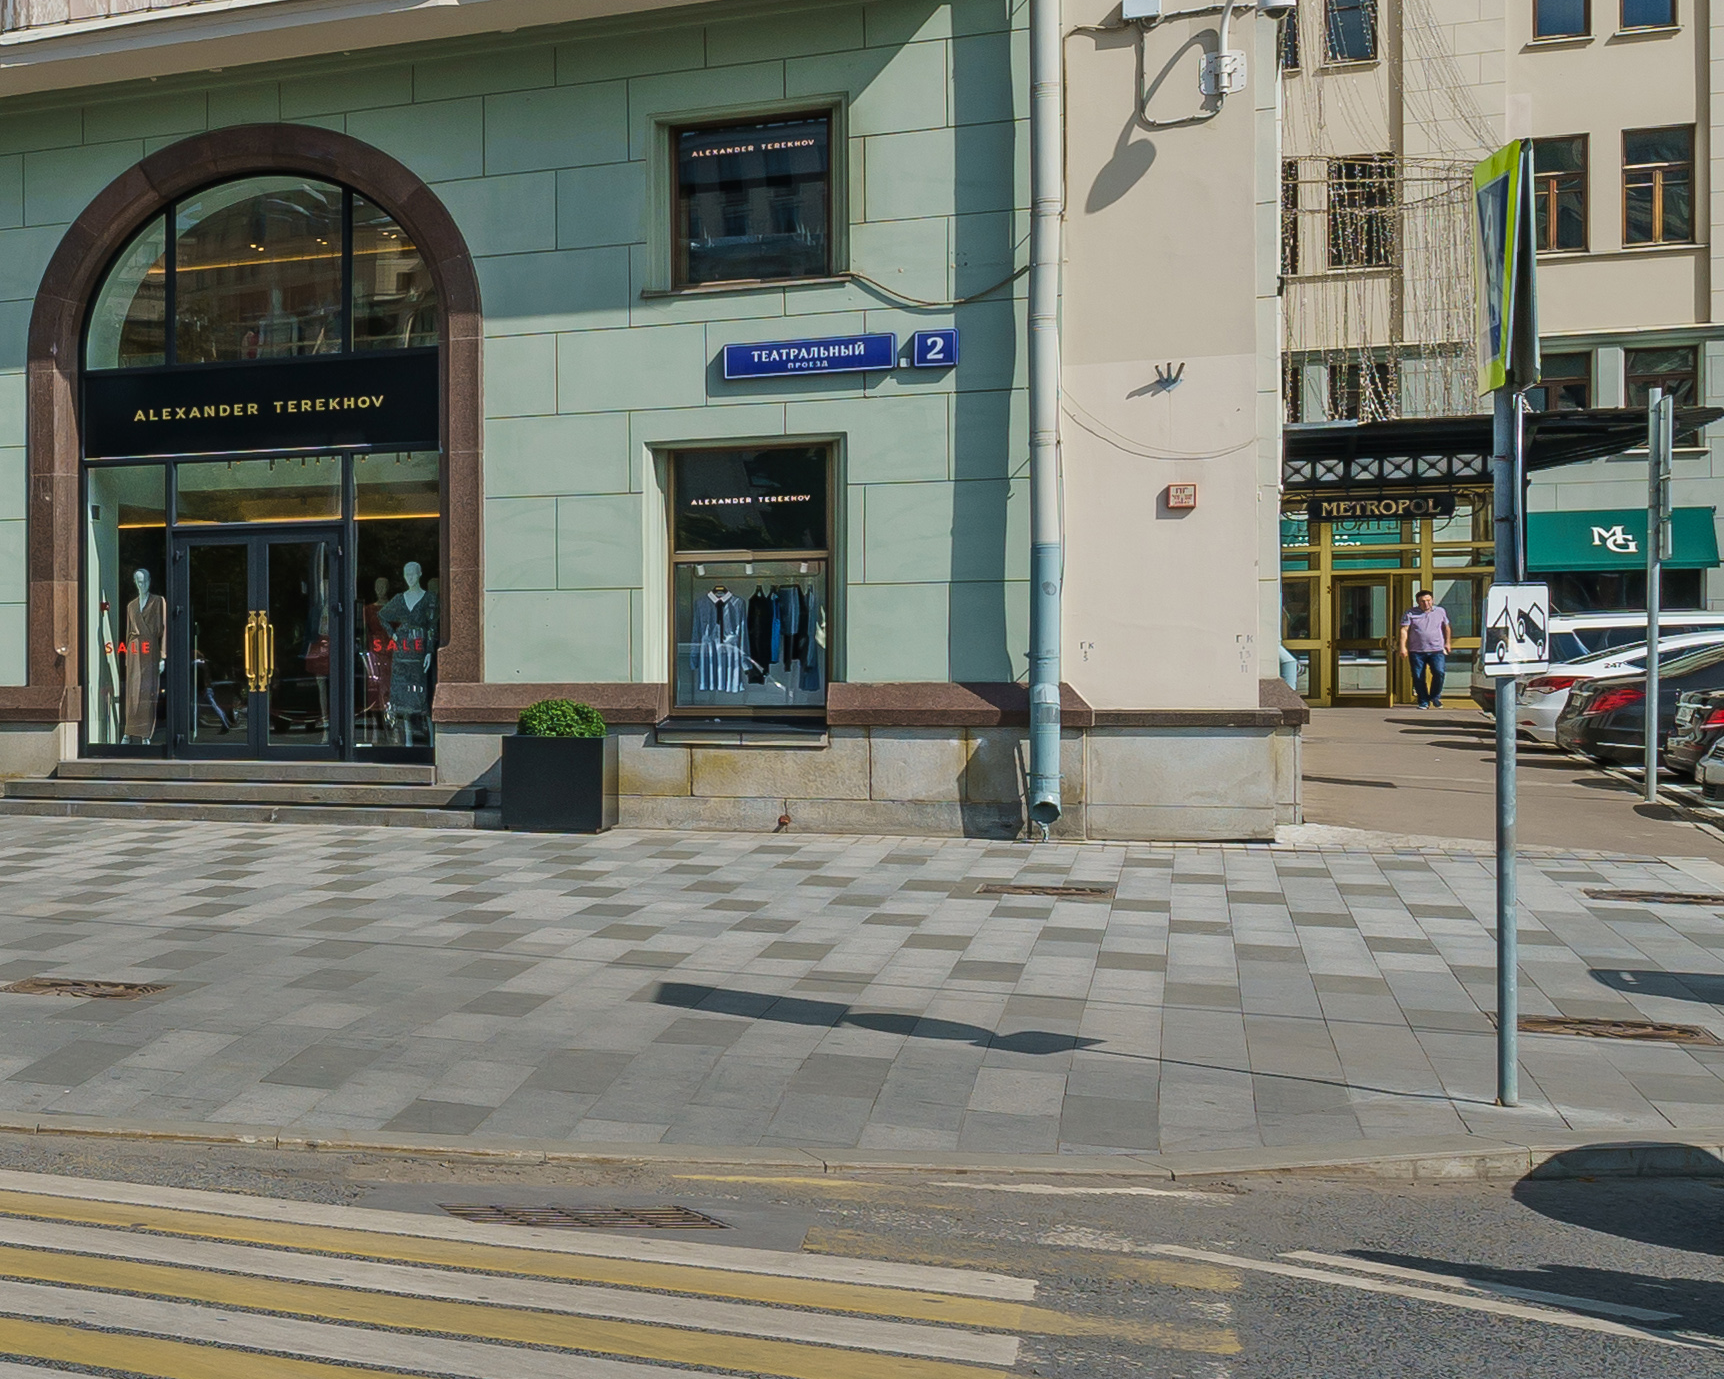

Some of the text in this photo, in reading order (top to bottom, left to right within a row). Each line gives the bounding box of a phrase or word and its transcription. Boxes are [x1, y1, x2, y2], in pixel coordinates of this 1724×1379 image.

[692, 139, 814, 158] ALEXANDER TEREKHOV
[751, 342, 865, 363] ТЕАТРАЛЬНЫЙ
[926, 337, 945, 360] 2
[787, 360, 829, 370] ПРОЕЗД
[134, 395, 384, 422] ALEXANDER TEREKHOV
[691, 494, 811, 506] ALEXANDER TEREKHOV
[1321, 498, 1442, 517] METROPOL
[1590, 525, 1639, 553] MG
[105, 641, 150, 654] SALE
[373, 639, 423, 652] SALE
